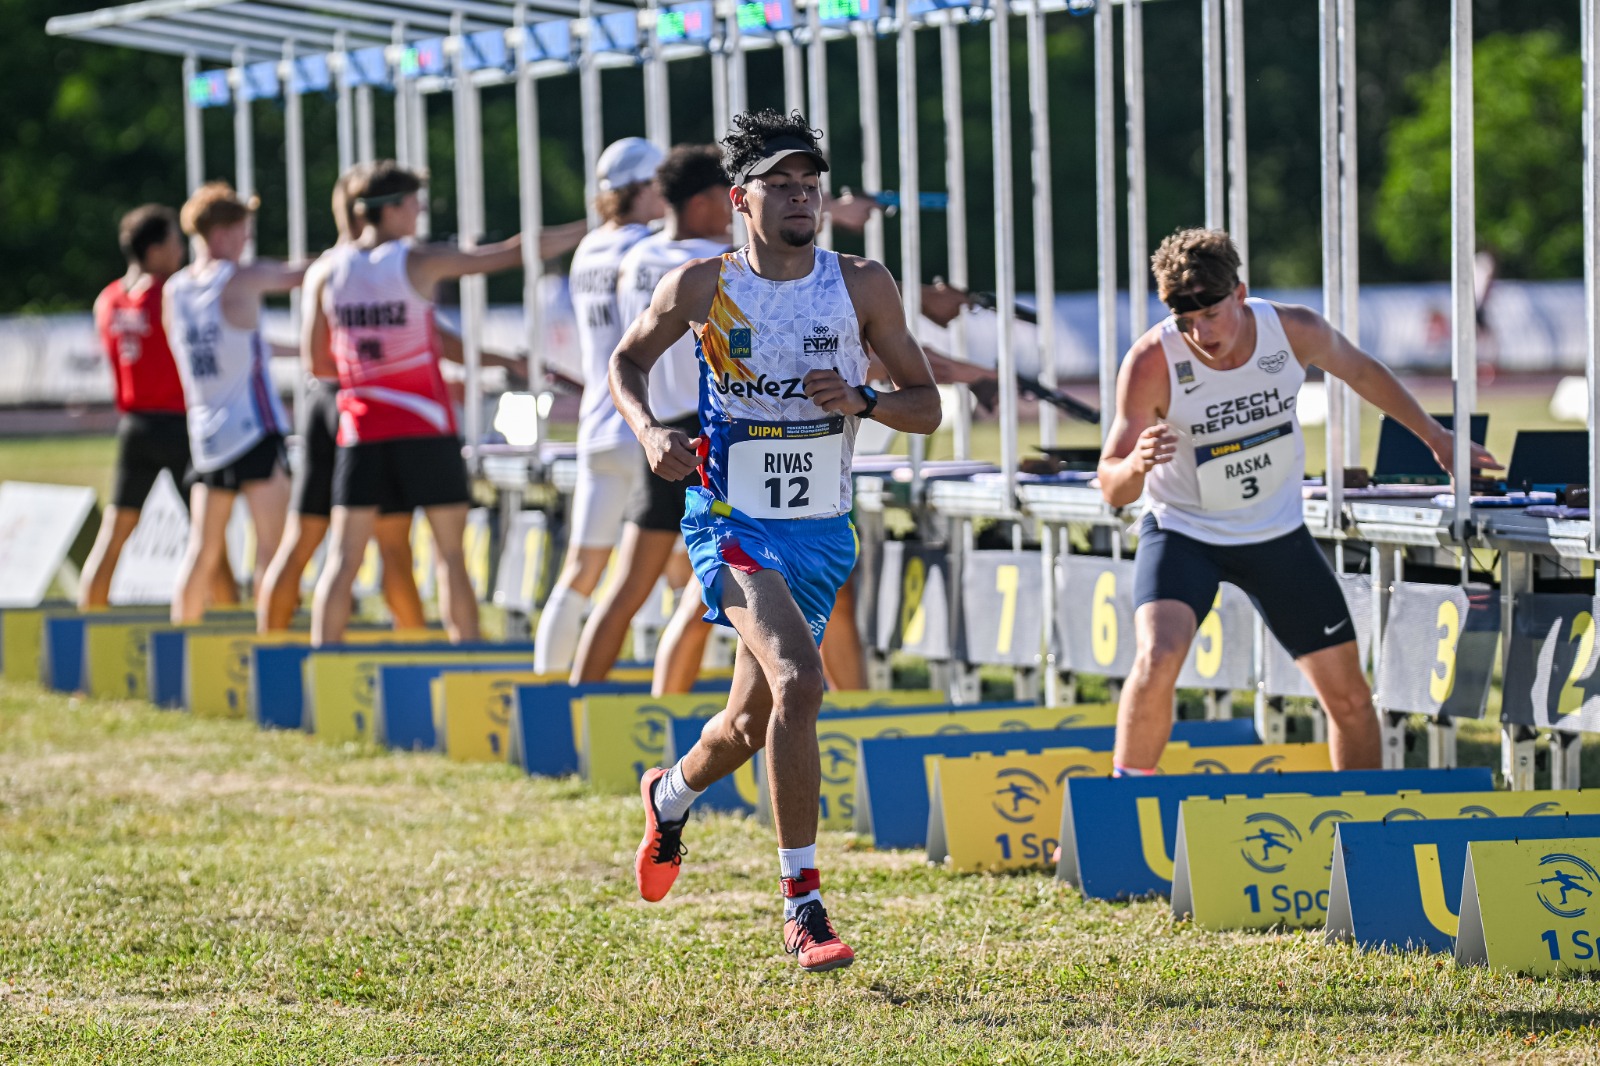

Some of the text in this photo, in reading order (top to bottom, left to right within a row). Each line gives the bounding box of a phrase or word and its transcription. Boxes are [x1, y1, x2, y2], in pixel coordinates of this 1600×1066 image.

[1190, 395, 1296, 435] REPUBLIC
[1205, 387, 1280, 419] CZECH
[748, 425, 783, 438] UIPM
[763, 451, 813, 474] RIVAS
[1210, 442, 1242, 458] UIPM
[1224, 452, 1272, 480] RASKA
[764, 476, 810, 509] 12
[1240, 475, 1260, 500] 3
[901, 555, 926, 646] 8
[996, 565, 1019, 654] 7
[1091, 571, 1119, 667] 6
[1429, 600, 1460, 703] 3
[1557, 610, 1596, 717] 2
[995, 832, 1012, 860] 1
[1244, 884, 1261, 913] 1
[1541, 929, 1600, 964] 1 S
